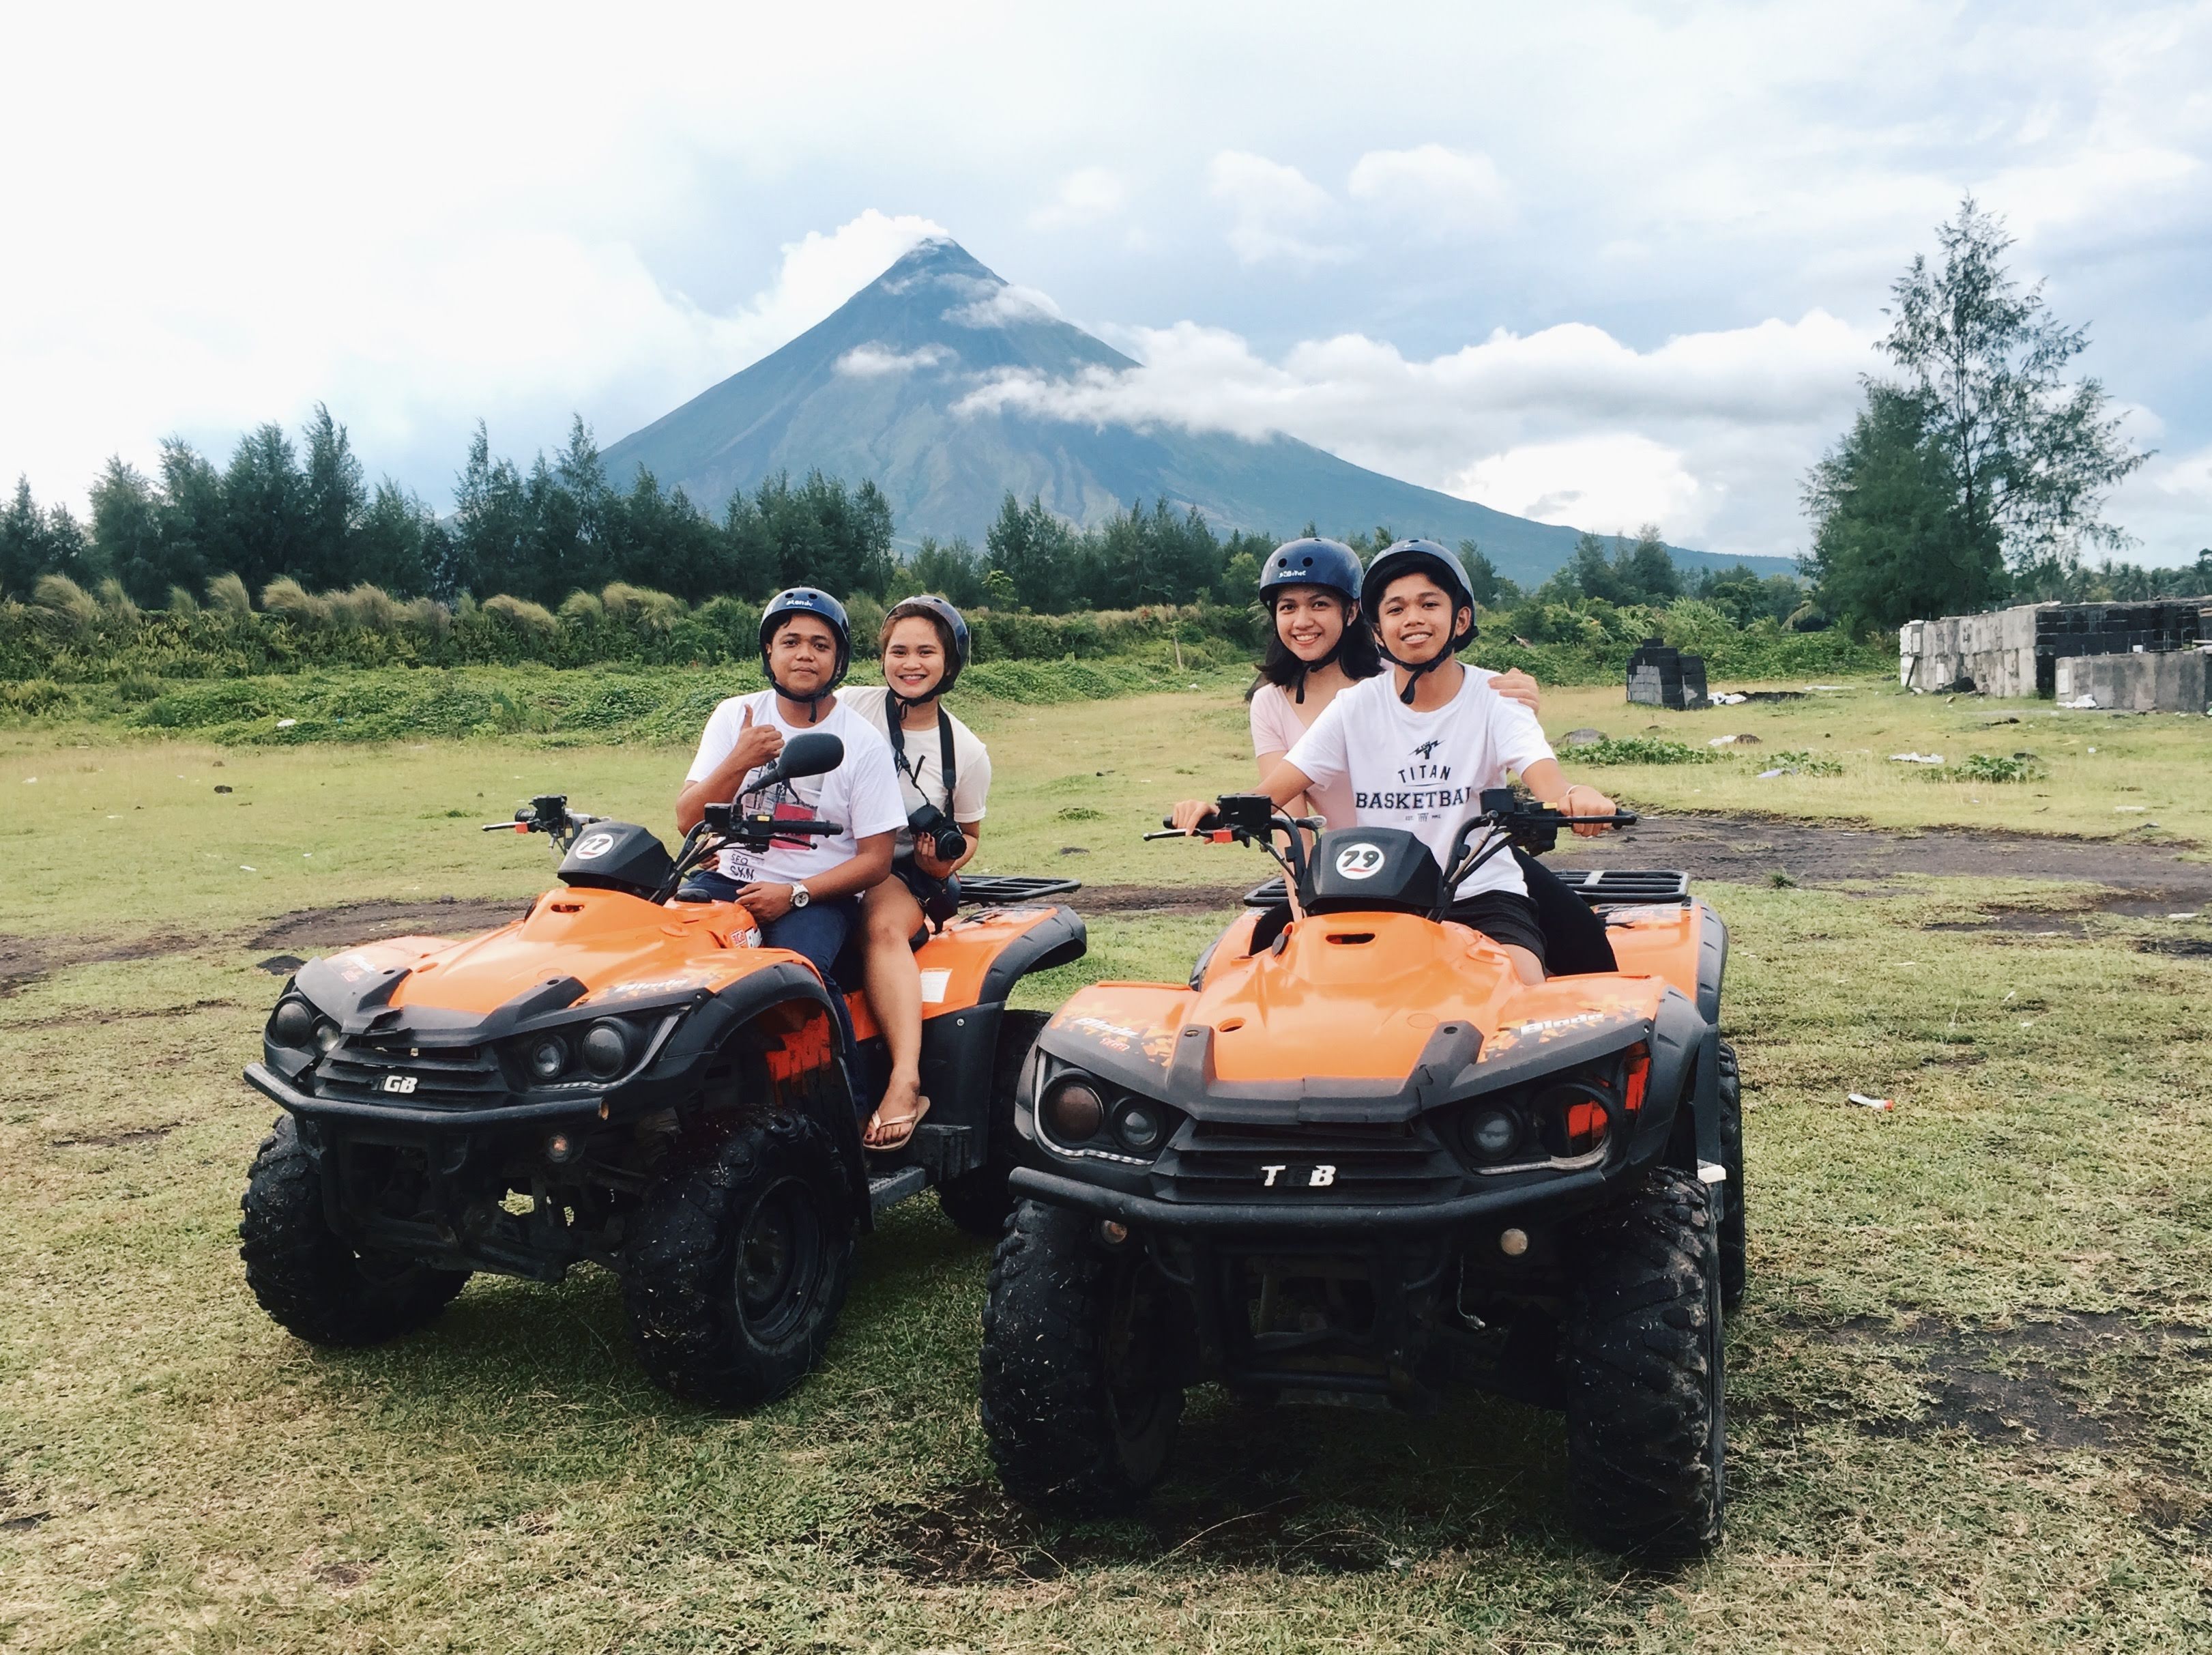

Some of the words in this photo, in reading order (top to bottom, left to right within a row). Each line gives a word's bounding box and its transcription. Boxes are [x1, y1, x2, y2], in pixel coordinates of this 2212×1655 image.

[1398, 764, 1451, 783] TITAN
[1342, 850, 1379, 867] 79
[1520, 1013, 1604, 1035] Blade
